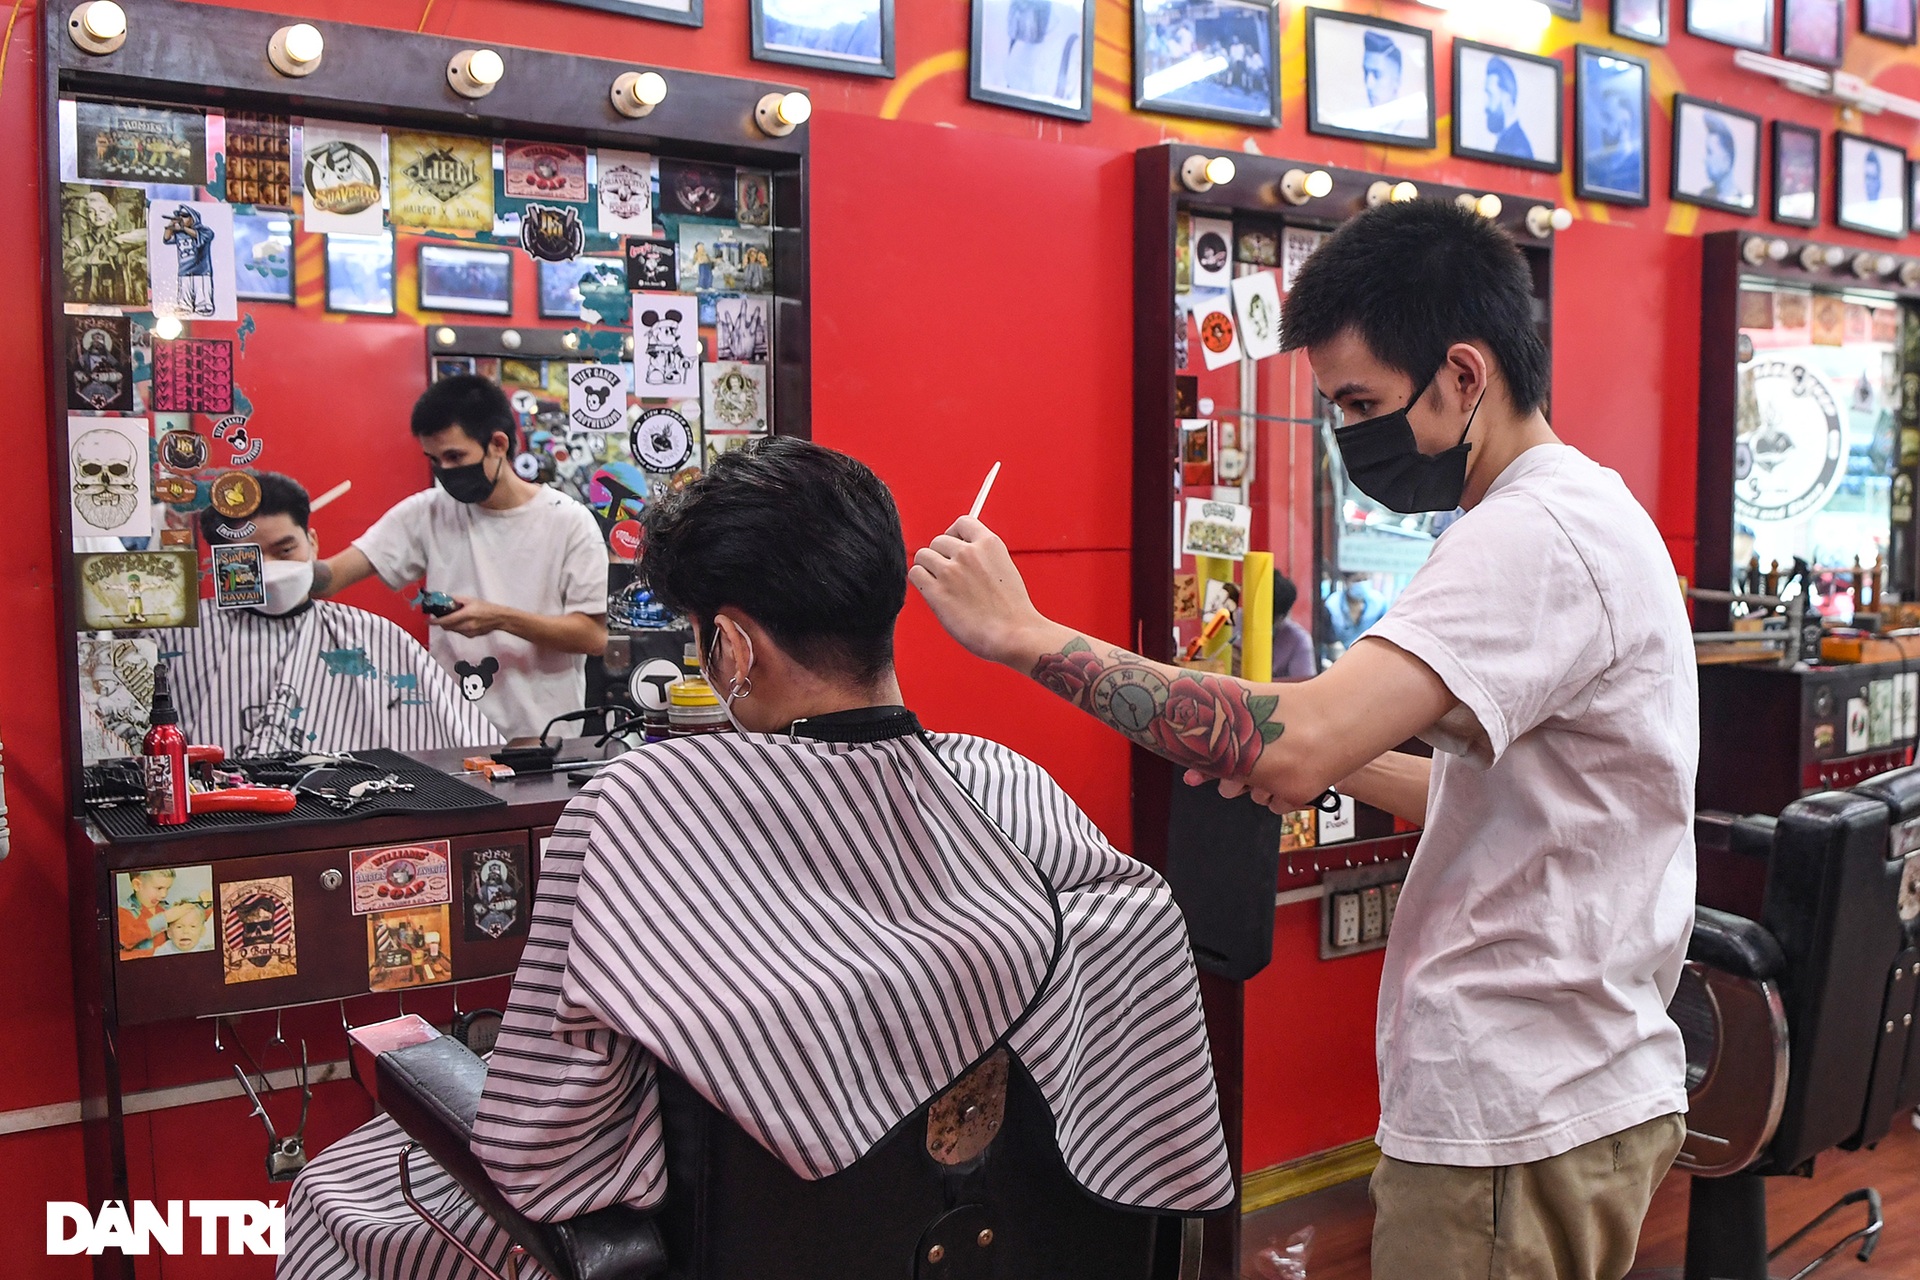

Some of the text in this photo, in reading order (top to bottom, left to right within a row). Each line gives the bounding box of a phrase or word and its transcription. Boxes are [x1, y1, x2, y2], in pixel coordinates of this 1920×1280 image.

[313, 183, 380, 210] SUAVECITO
[403, 203, 436, 215] HAIRCUT
[456, 208, 480, 219] SHAVE
[219, 549, 256, 564] Surfing
[222, 592, 259, 601] HAWAII
[371, 850, 429, 867] WILLIAMS'
[377, 880, 425, 900] SOAP
